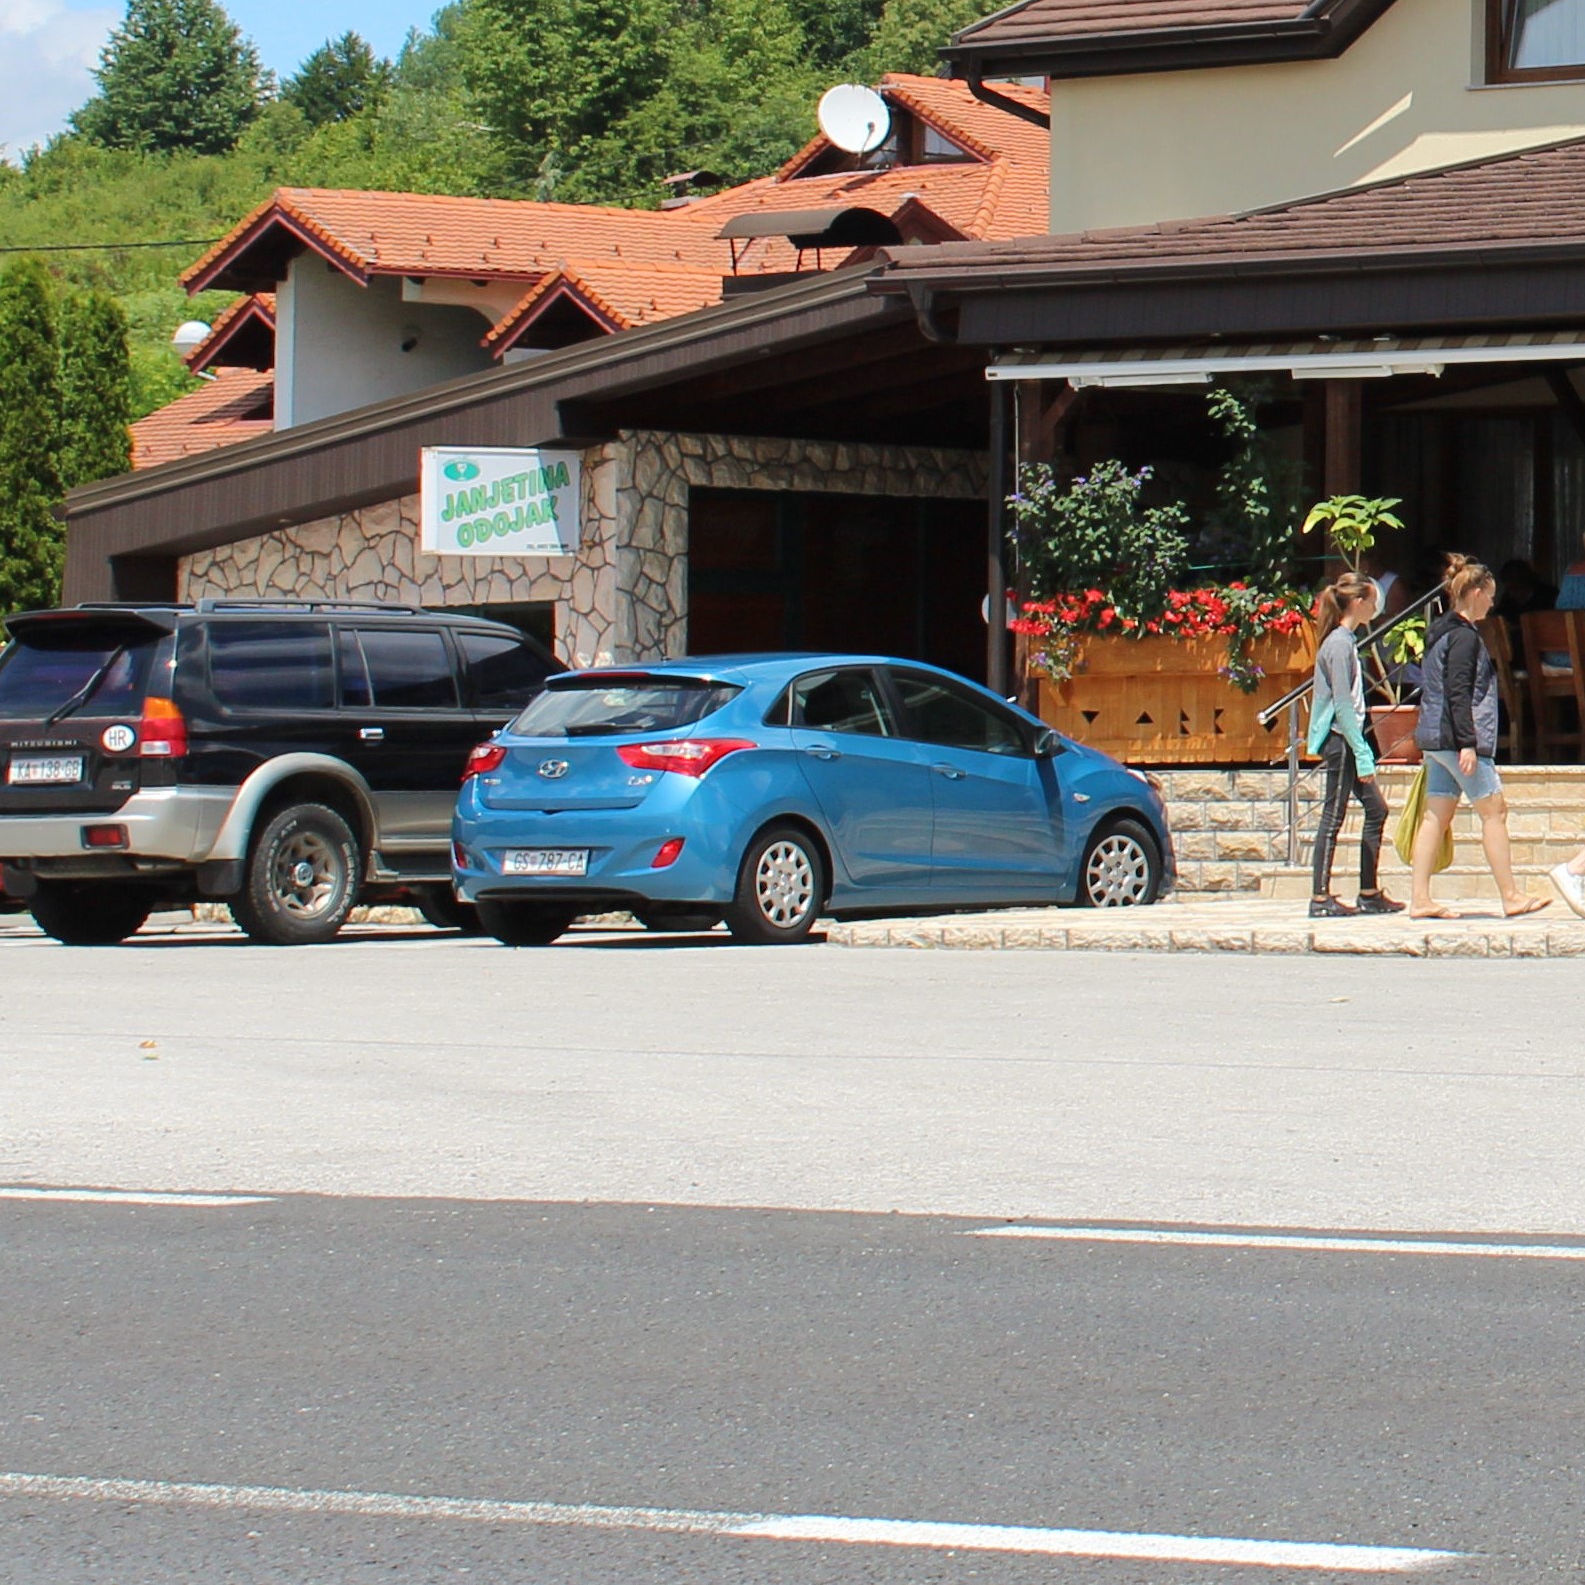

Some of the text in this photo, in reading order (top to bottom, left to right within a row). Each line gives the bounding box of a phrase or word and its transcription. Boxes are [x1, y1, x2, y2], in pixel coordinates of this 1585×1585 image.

[440, 460, 571, 523] JANJETINA
[456, 494, 559, 549] ODOJAK
[108, 729, 128, 748] HR
